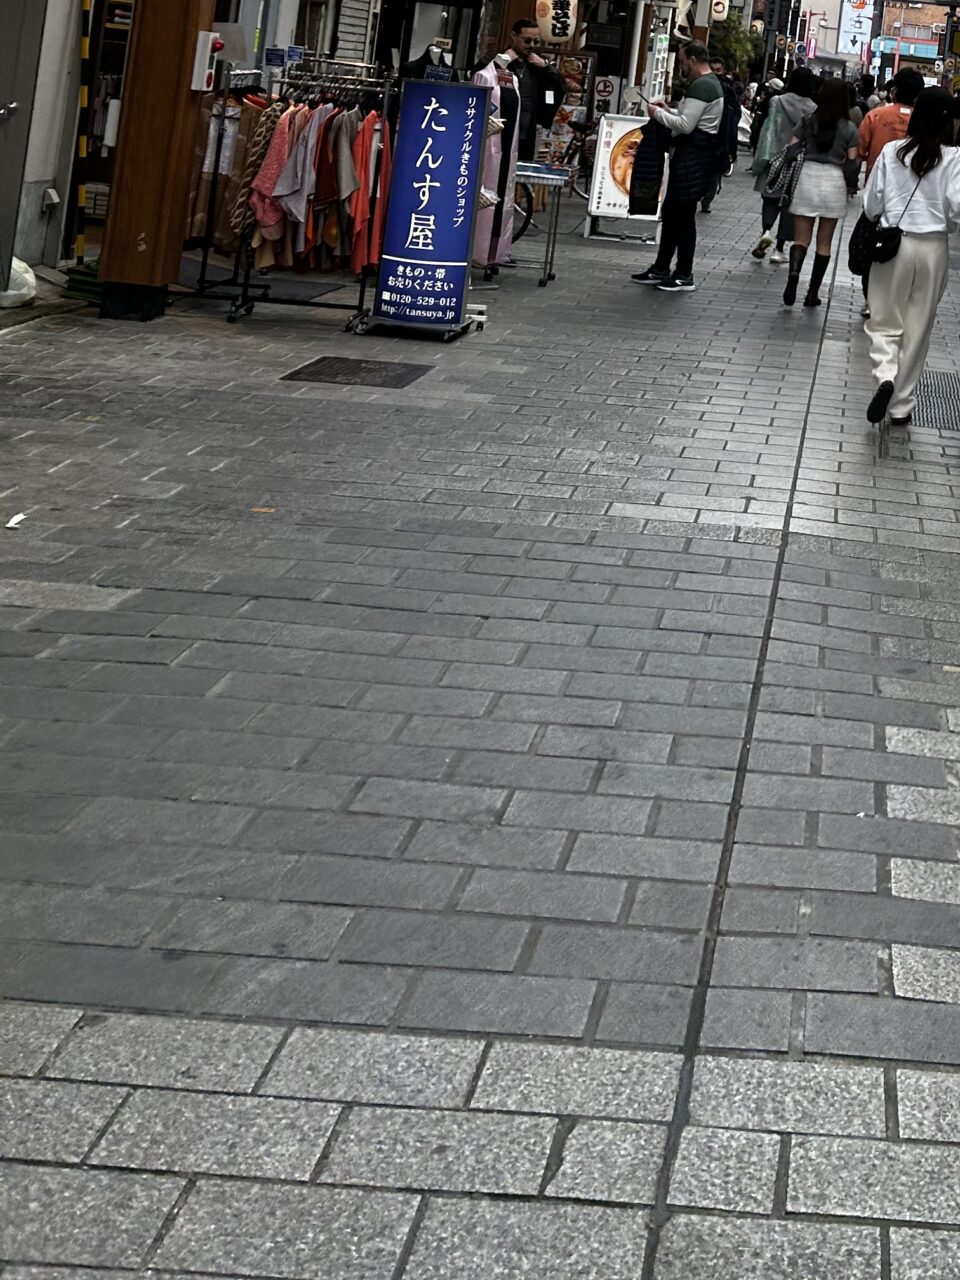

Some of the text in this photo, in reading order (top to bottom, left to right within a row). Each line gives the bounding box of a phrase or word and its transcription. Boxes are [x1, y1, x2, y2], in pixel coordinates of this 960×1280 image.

[453, 96, 477, 228] リサイクルきものショップ
[405, 97, 449, 251] たんす屋
[387, 276, 454, 291] お売りください
[391, 294, 457, 307] 0120-529-012
[381, 303, 455, 320] http://tansuya.jp
